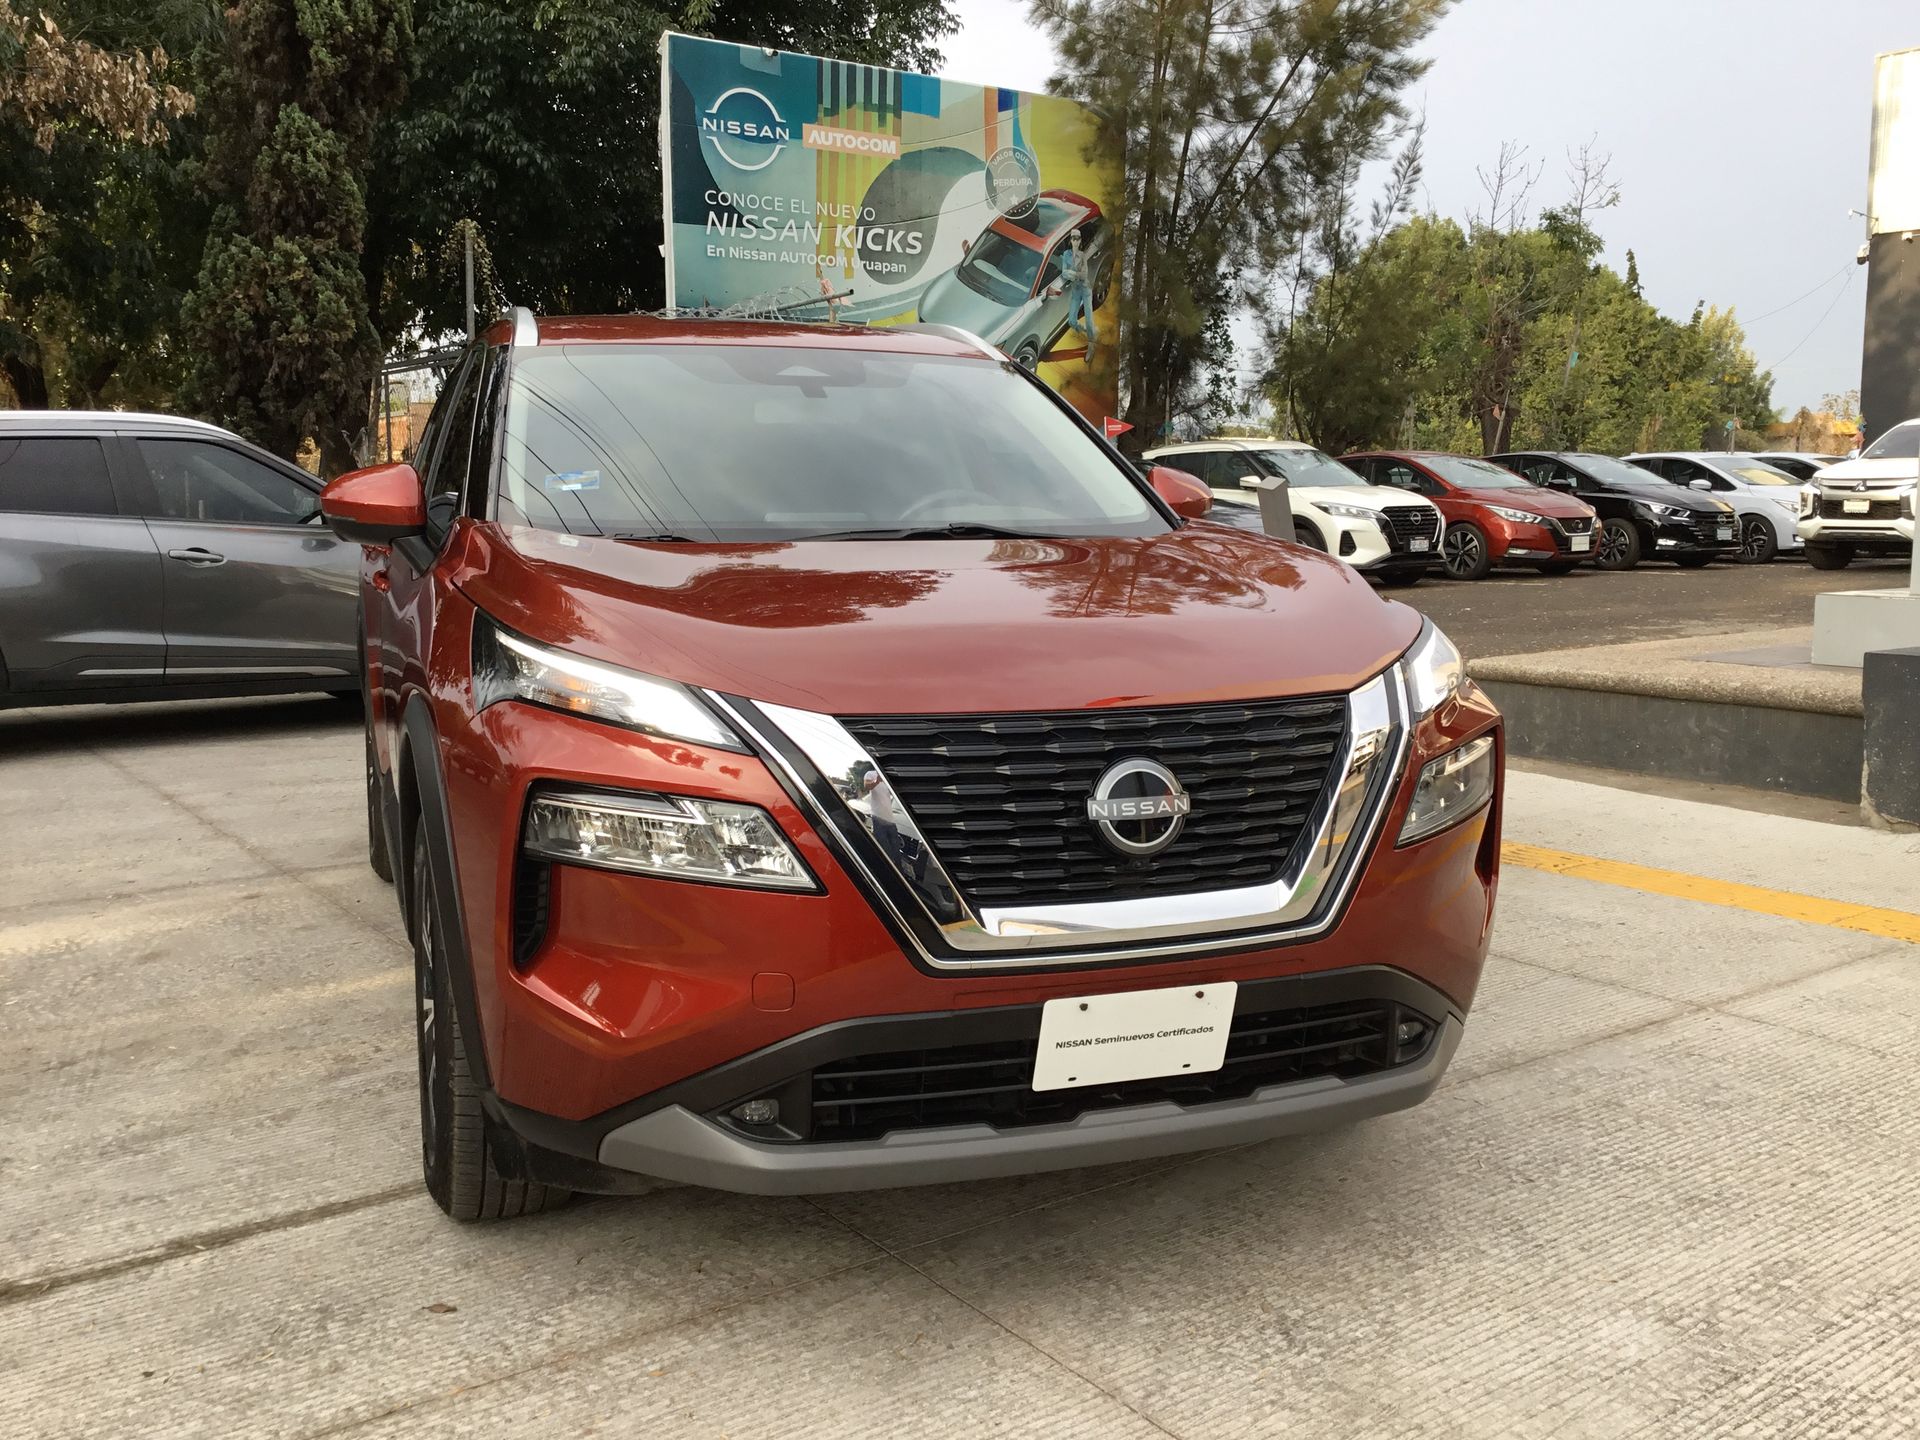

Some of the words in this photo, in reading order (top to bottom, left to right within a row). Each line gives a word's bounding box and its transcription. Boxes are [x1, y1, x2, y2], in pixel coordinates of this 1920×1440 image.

[702, 117, 790, 141] NISSAN
[808, 130, 896, 155] AUTOCOM
[992, 151, 1013, 165] VALOR
[993, 177, 1033, 187] PERDURA
[704, 190, 784, 212] CONOCE
[790, 199, 811, 214] EL
[816, 202, 876, 221] NUEVO
[705, 211, 822, 245] NISSAN
[834, 224, 923, 255] KICKS
[707, 245, 726, 258] En
[729, 246, 777, 263] Nissan
[780, 252, 848, 268] AUTOCOM
[852, 257, 907, 274] Uruapan
[1092, 798, 1188, 817] NISSAN
[1055, 1038, 1093, 1050] NISSAN
[1094, 1033, 1155, 1046] Seminuevos
[1156, 1024, 1214, 1039] Certificados
